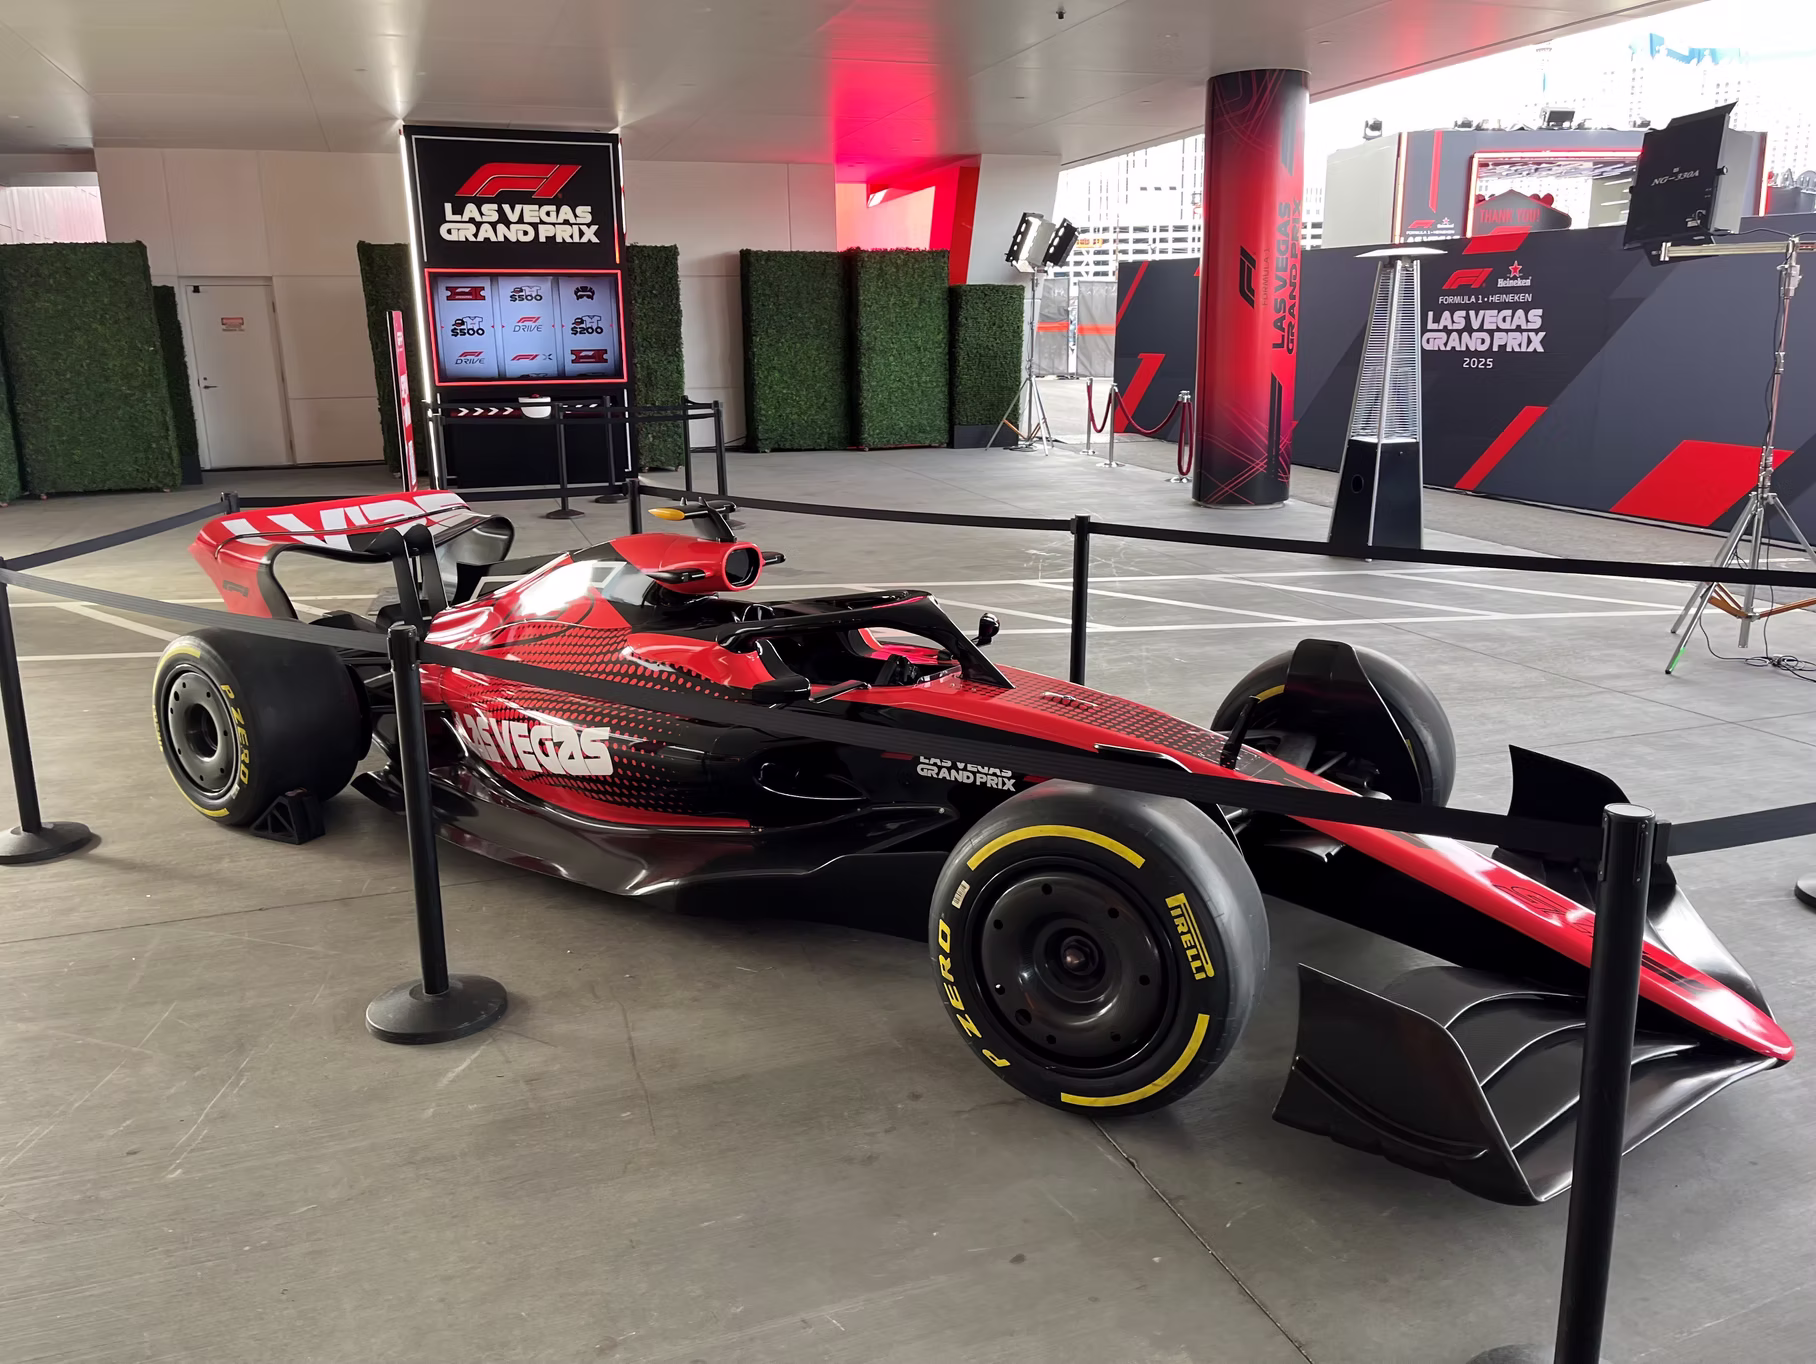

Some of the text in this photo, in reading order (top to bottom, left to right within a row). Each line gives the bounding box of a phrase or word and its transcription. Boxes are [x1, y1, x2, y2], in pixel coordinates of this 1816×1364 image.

[455, 162, 582, 198] F1
[1651, 169, 1700, 187] NG-330A
[444, 203, 593, 223] LAS VEGAS
[1480, 207, 1542, 223] THANK YOU!
[440, 223, 601, 243] GRAND PRIX
[1261, 256, 1270, 307] FORMULA
[1272, 201, 1291, 349] LAS VEGAS
[1287, 197, 1302, 355] GRAND PRIX
[1497, 276, 1532, 288] Heineken
[510, 294, 543, 303] $500
[1439, 293, 1533, 304] FORMULA 1 HEINEKEN
[513, 324, 543, 333] DRIVE
[1427, 308, 1543, 330] LAS VEGAS
[450, 327, 485, 337] $500
[570, 326, 604, 336] $200
[1421, 331, 1546, 352] GRAND PRIX
[1462, 358, 1494, 369] 2025
[221, 684, 250, 785] P ZERO
[489, 717, 614, 776] VEGAS
[916, 764, 1016, 792] GRAND PRIX
[1165, 892, 1215, 980] PIRELLI
[939, 919, 982, 1038] ZERO
[982, 1049, 1011, 1067] P
